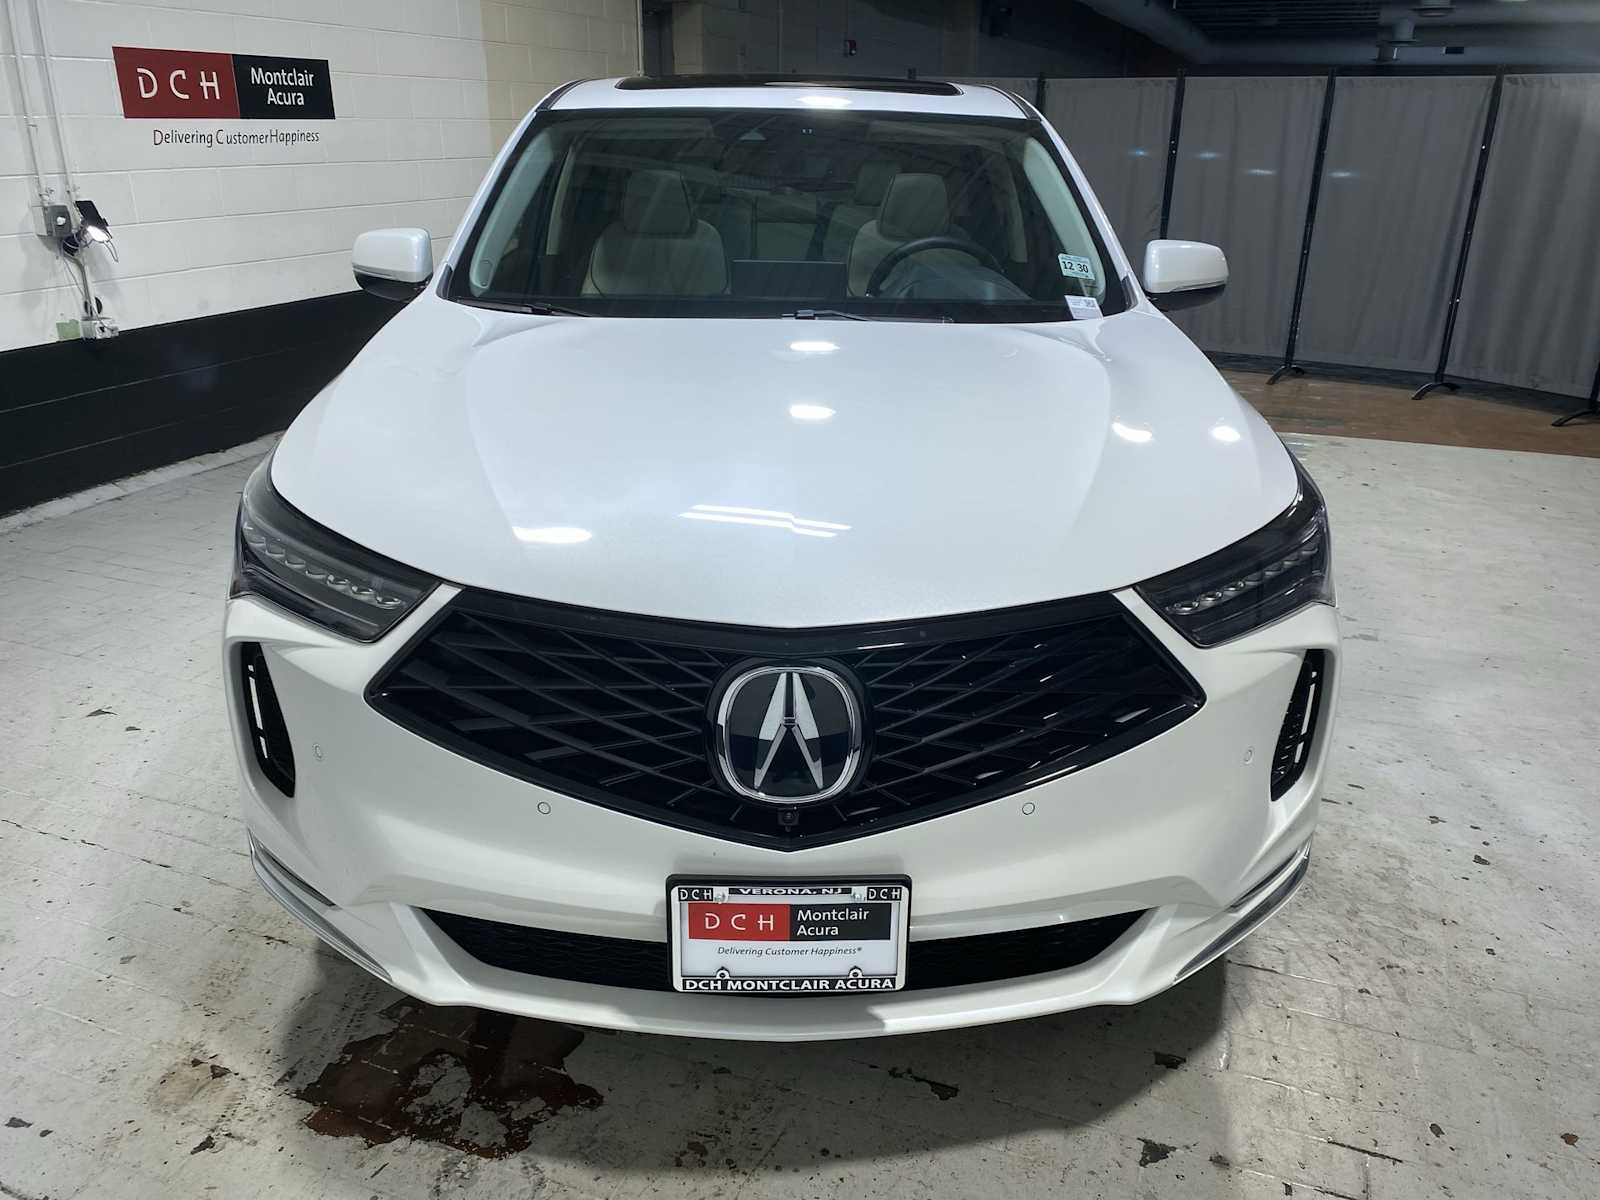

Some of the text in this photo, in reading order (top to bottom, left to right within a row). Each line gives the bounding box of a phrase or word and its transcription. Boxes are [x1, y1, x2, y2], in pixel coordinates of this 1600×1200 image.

[251, 67, 315, 86] Montclair
[136, 67, 220, 100] DCH
[267, 88, 305, 105] Acura
[153, 129, 213, 148] Delivering
[1062, 261, 1089, 273] 12 30
[680, 889, 712, 900] DCH
[868, 888, 901, 899] DCH
[797, 908, 870, 921] Montclair
[704, 912, 774, 931] DCH
[796, 924, 839, 936] Acura
[717, 946, 763, 957] Delivering
[765, 947, 808, 956] Customer
[685, 978, 893, 990] DCH MONTCLAIR ACURA
